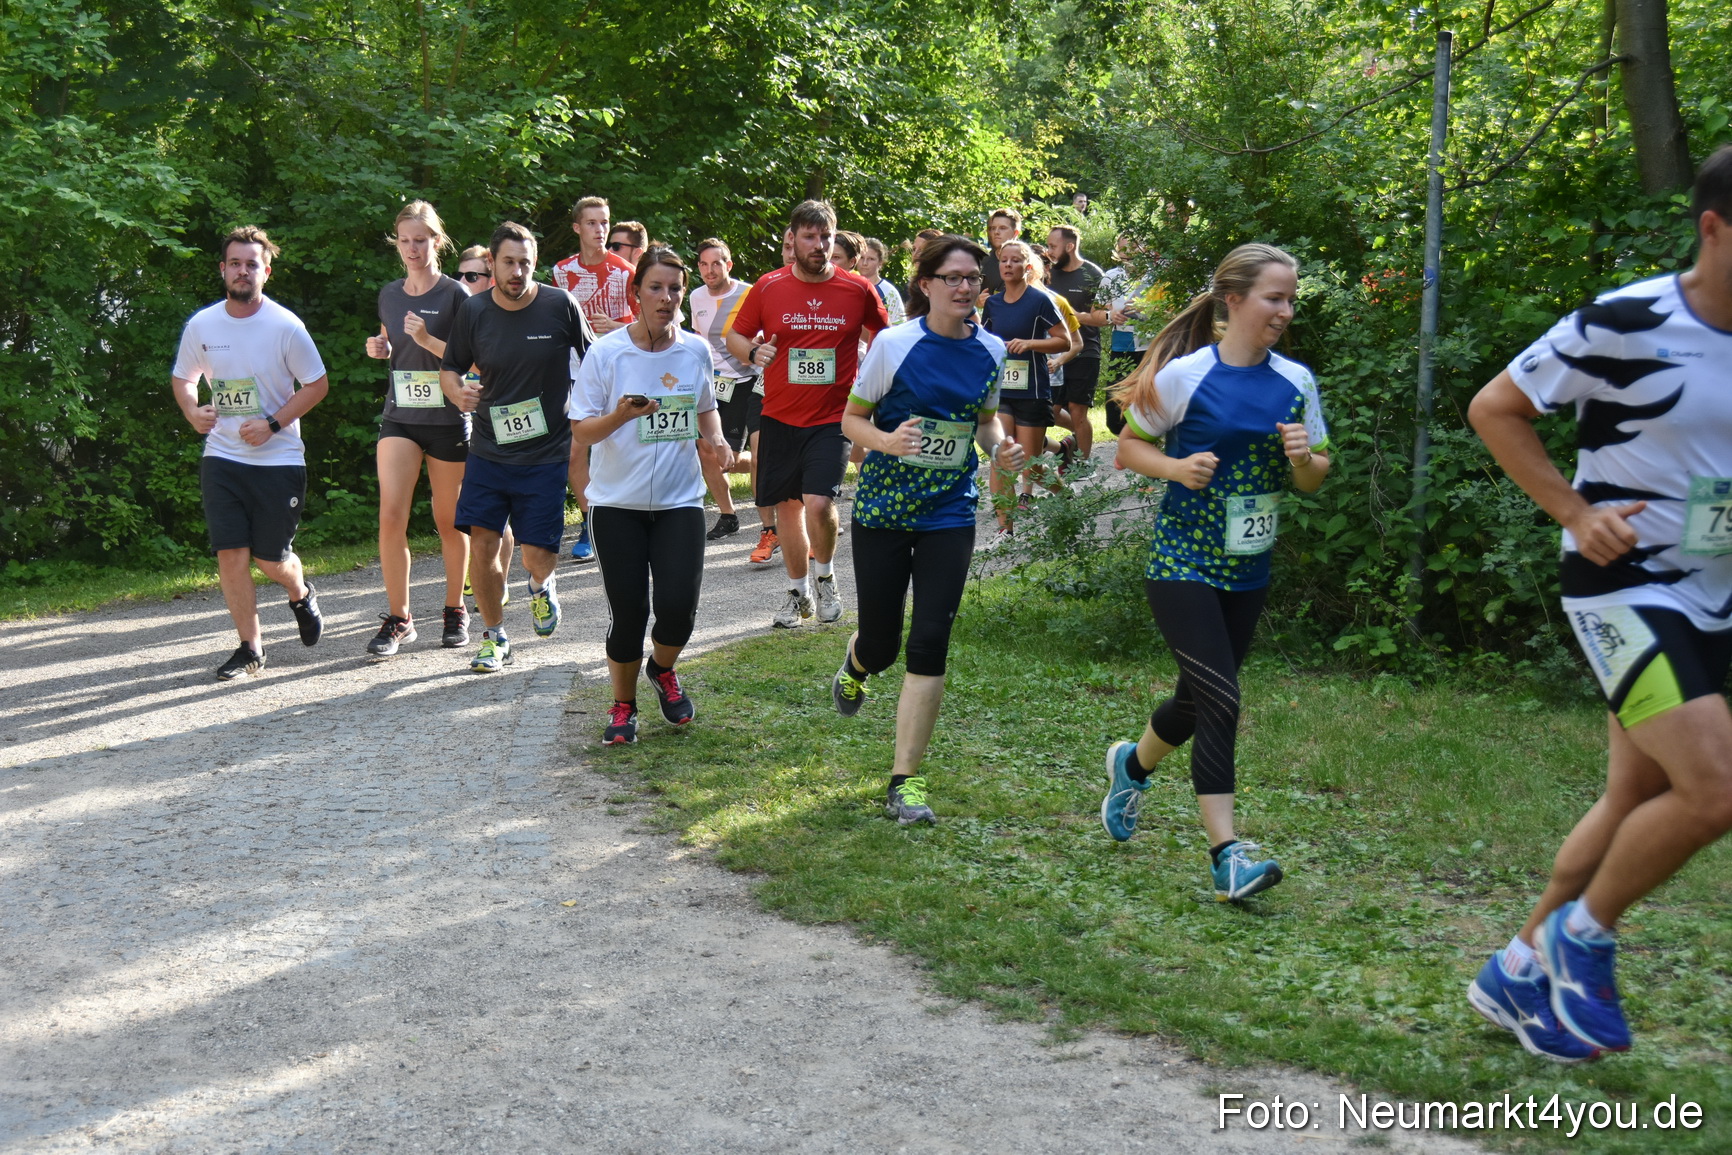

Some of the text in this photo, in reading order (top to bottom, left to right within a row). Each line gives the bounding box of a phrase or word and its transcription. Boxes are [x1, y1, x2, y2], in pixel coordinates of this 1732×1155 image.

[782, 313, 846, 325] Echtes Handwerk
[798, 362, 825, 375] 588
[216, 391, 251, 406] 2147
[405, 384, 431, 398] 159
[503, 414, 532, 433] 181
[646, 411, 688, 429] 1371
[921, 436, 956, 456] 220
[1242, 514, 1273, 538] 233
